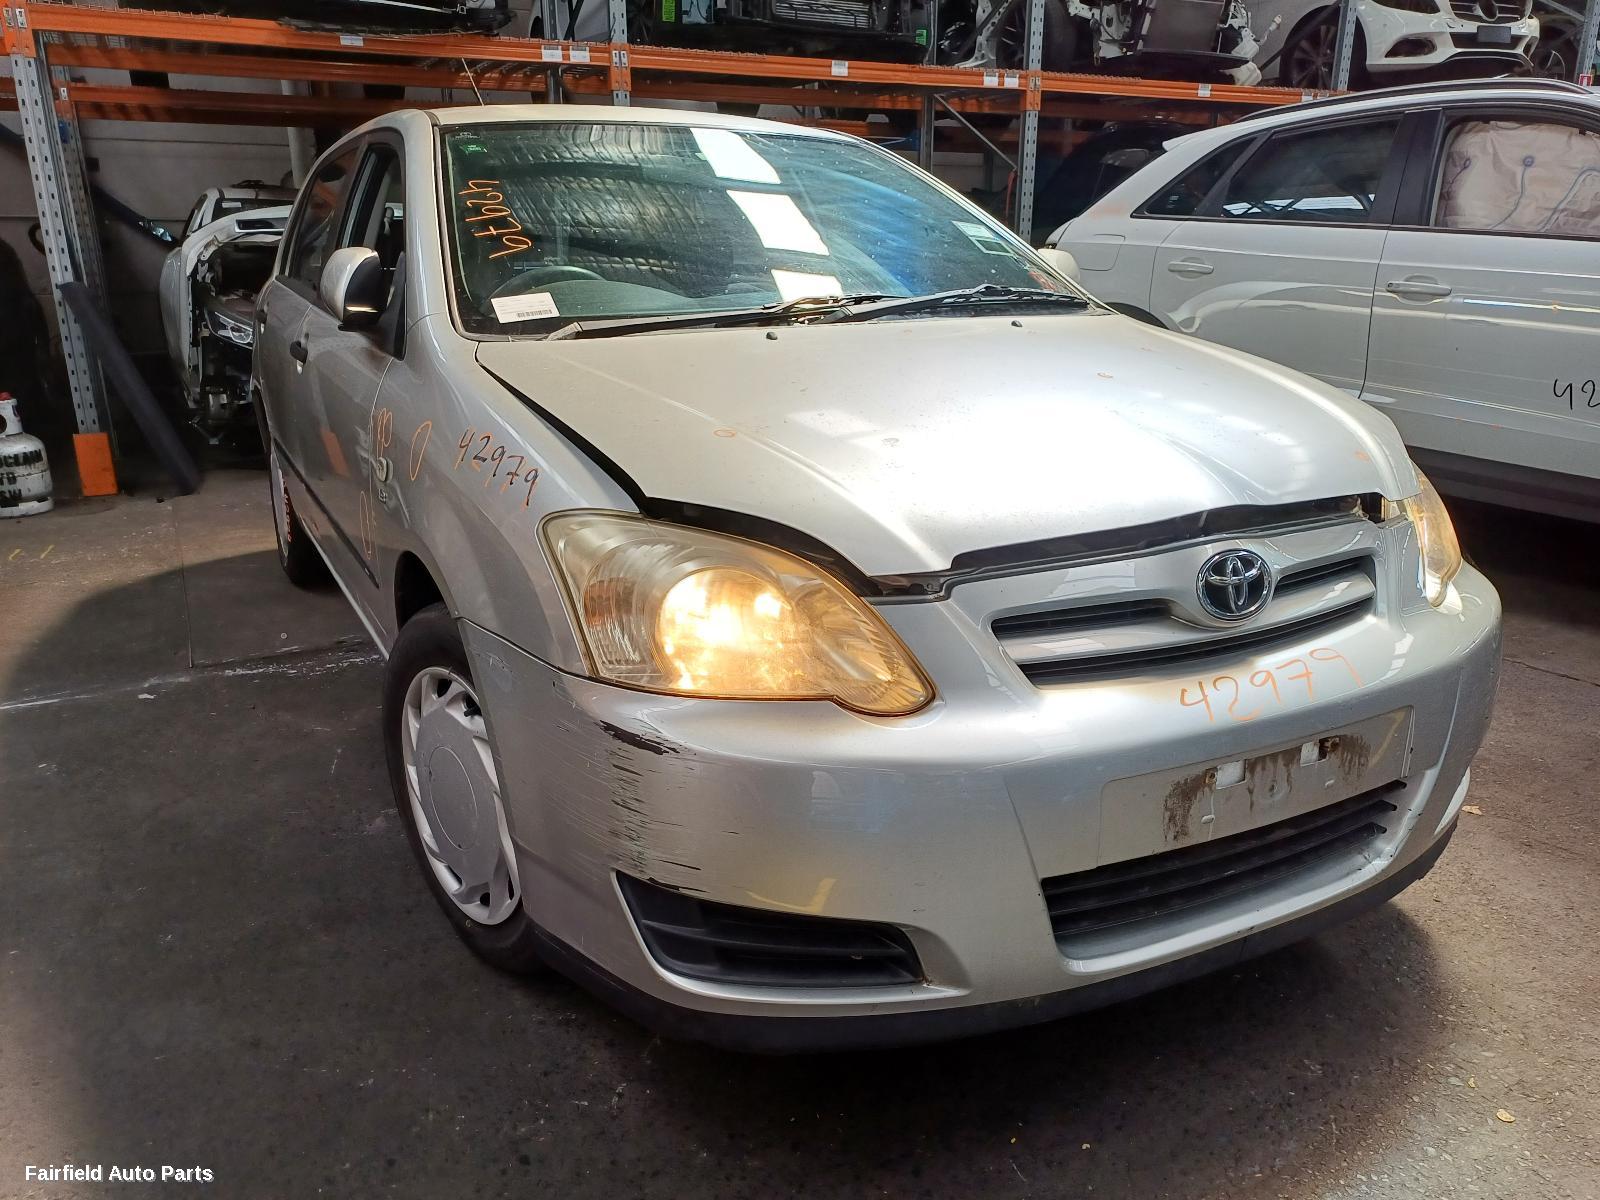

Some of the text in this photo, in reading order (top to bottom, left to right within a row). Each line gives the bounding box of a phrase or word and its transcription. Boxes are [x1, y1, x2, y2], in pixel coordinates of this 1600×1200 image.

[458, 179, 532, 259] 42979
[1553, 378, 1600, 411] 42
[455, 427, 539, 510] 42979
[1180, 646, 1364, 723] 42979
